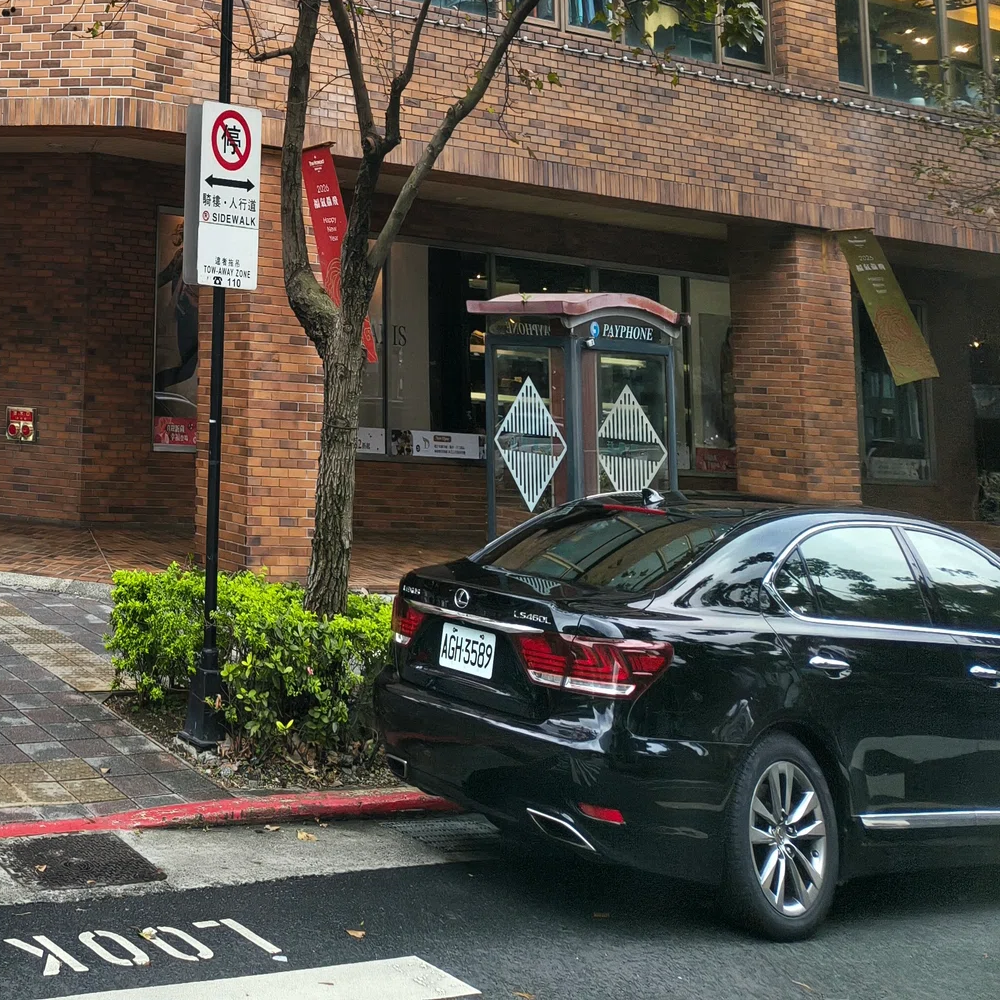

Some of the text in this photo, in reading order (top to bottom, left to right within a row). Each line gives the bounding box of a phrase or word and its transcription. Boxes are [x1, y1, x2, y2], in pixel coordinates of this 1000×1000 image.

[212, 212, 256, 226] SIDEWALK
[203, 265, 251, 279] TOW-AWAY ZONE
[227, 278, 241, 287] 110
[602, 323, 654, 341] PAYPHONE
[3, 918, 283, 976] LOOK
